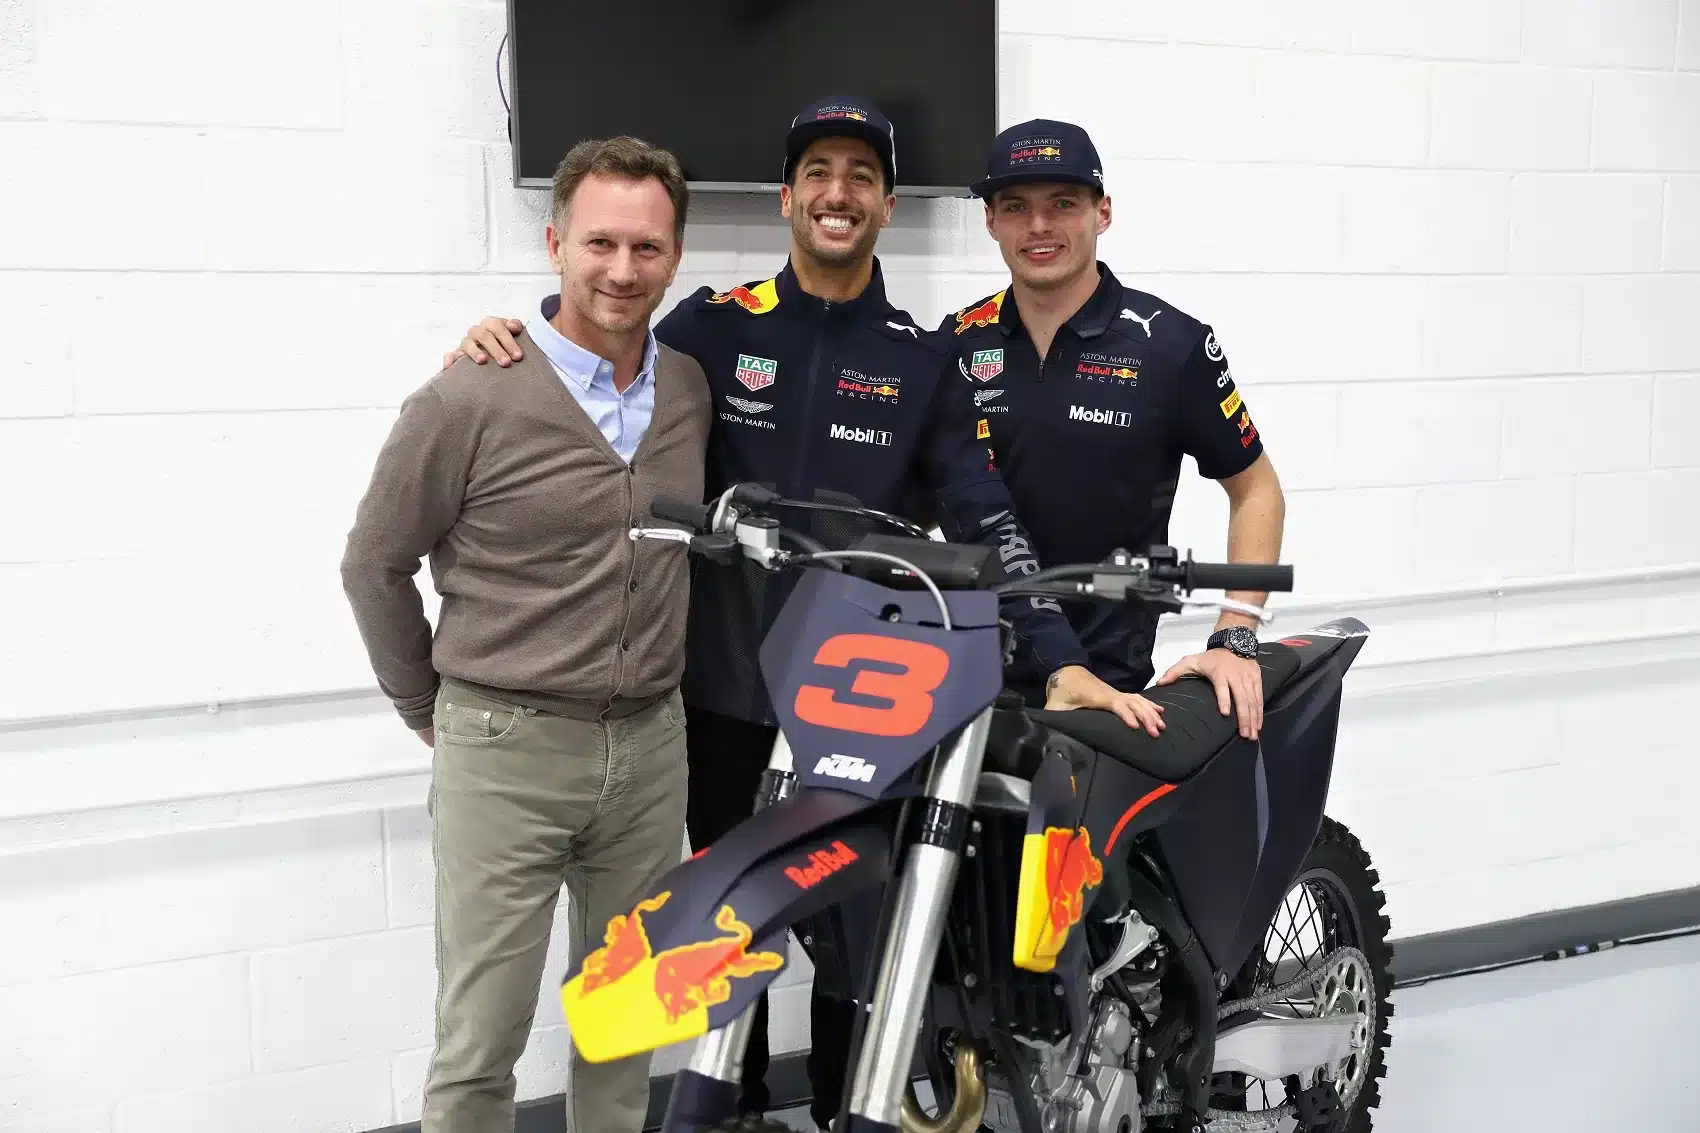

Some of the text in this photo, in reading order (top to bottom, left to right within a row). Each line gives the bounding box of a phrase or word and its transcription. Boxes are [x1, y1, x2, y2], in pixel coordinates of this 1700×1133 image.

[841, 105, 868, 116] MARTIN
[1011, 140, 1031, 149] ASTON
[1010, 156, 1061, 165] RACING
[975, 351, 1001, 363] TAG
[1079, 352, 1143, 366] ASTON MARTIN
[742, 357, 773, 373] TAG
[972, 363, 1002, 380] HEUER
[738, 369, 773, 389] HEUER
[840, 368, 867, 381] ASTON
[1075, 373, 1137, 387] RACING
[836, 389, 898, 404] RACING
[1069, 404, 1114, 425] Mobil
[744, 418, 776, 430] MARTIN
[829, 423, 875, 444] Mobil
[794, 633, 949, 737] 3
[813, 753, 876, 783] KTM
